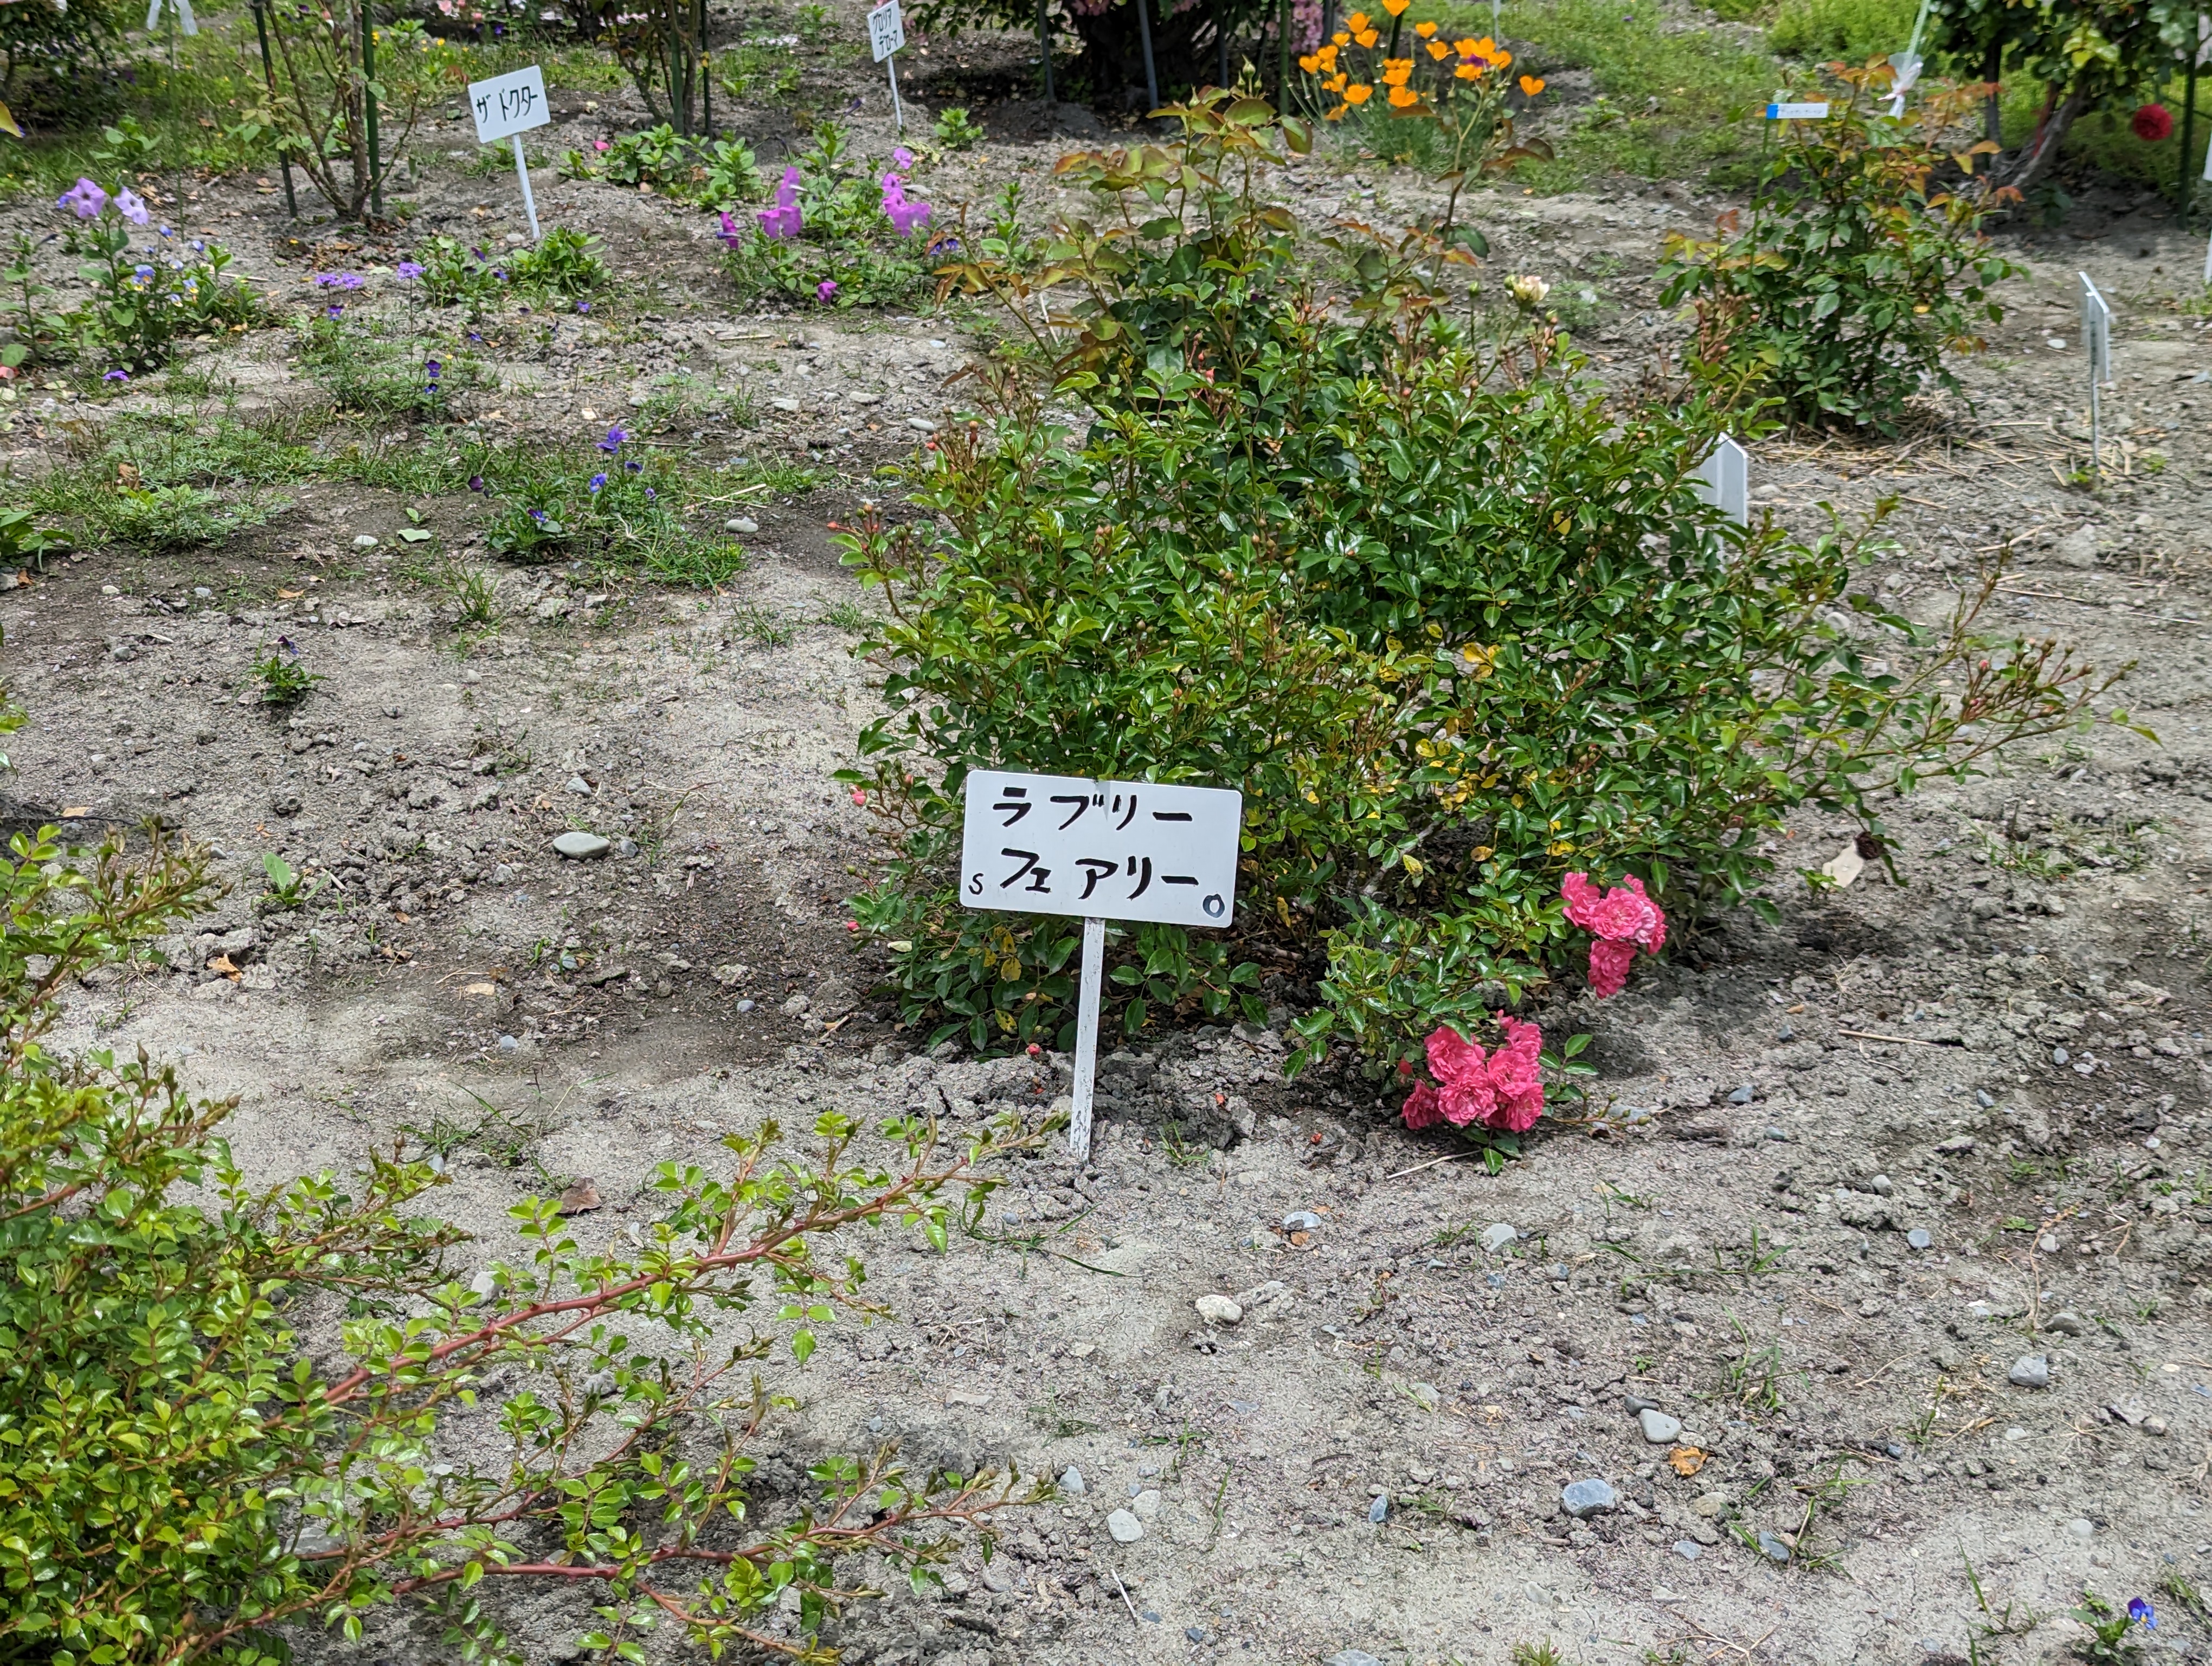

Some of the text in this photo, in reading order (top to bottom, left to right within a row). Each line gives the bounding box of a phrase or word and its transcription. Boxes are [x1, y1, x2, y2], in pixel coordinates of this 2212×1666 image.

[499, 86, 538, 121] ドクター
[993, 786, 1193, 831] ラブリー
[999, 848, 1199, 901] フェアリー
